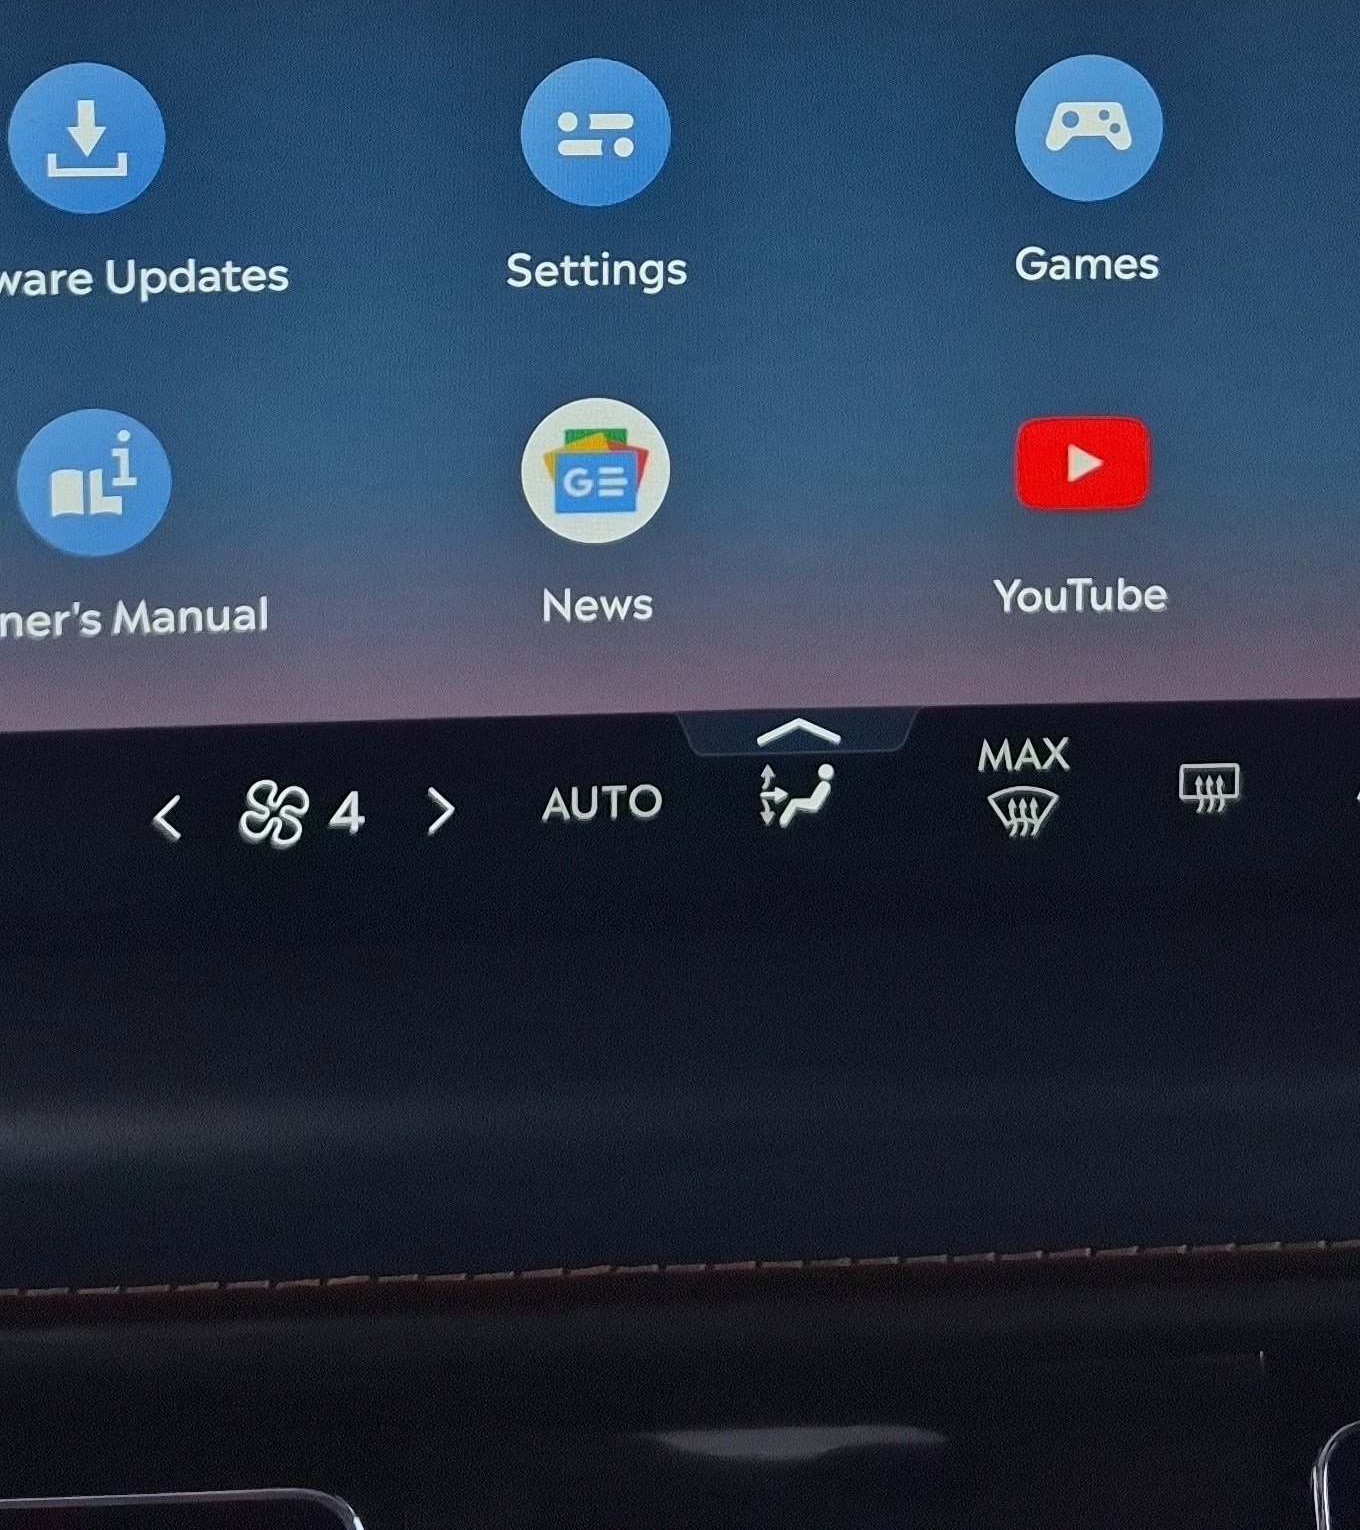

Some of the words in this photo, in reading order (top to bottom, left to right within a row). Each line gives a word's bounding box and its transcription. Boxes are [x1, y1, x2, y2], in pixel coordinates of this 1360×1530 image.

[106, 258, 289, 303] Updates
[507, 251, 688, 295] Settings
[1015, 246, 1160, 282] Games
[543, 588, 653, 623] News
[993, 577, 1168, 614] YouTube
[112, 596, 268, 635] Manual
[977, 736, 1070, 772] MAX
[329, 790, 366, 834] 4
[541, 783, 663, 822] AUTO
